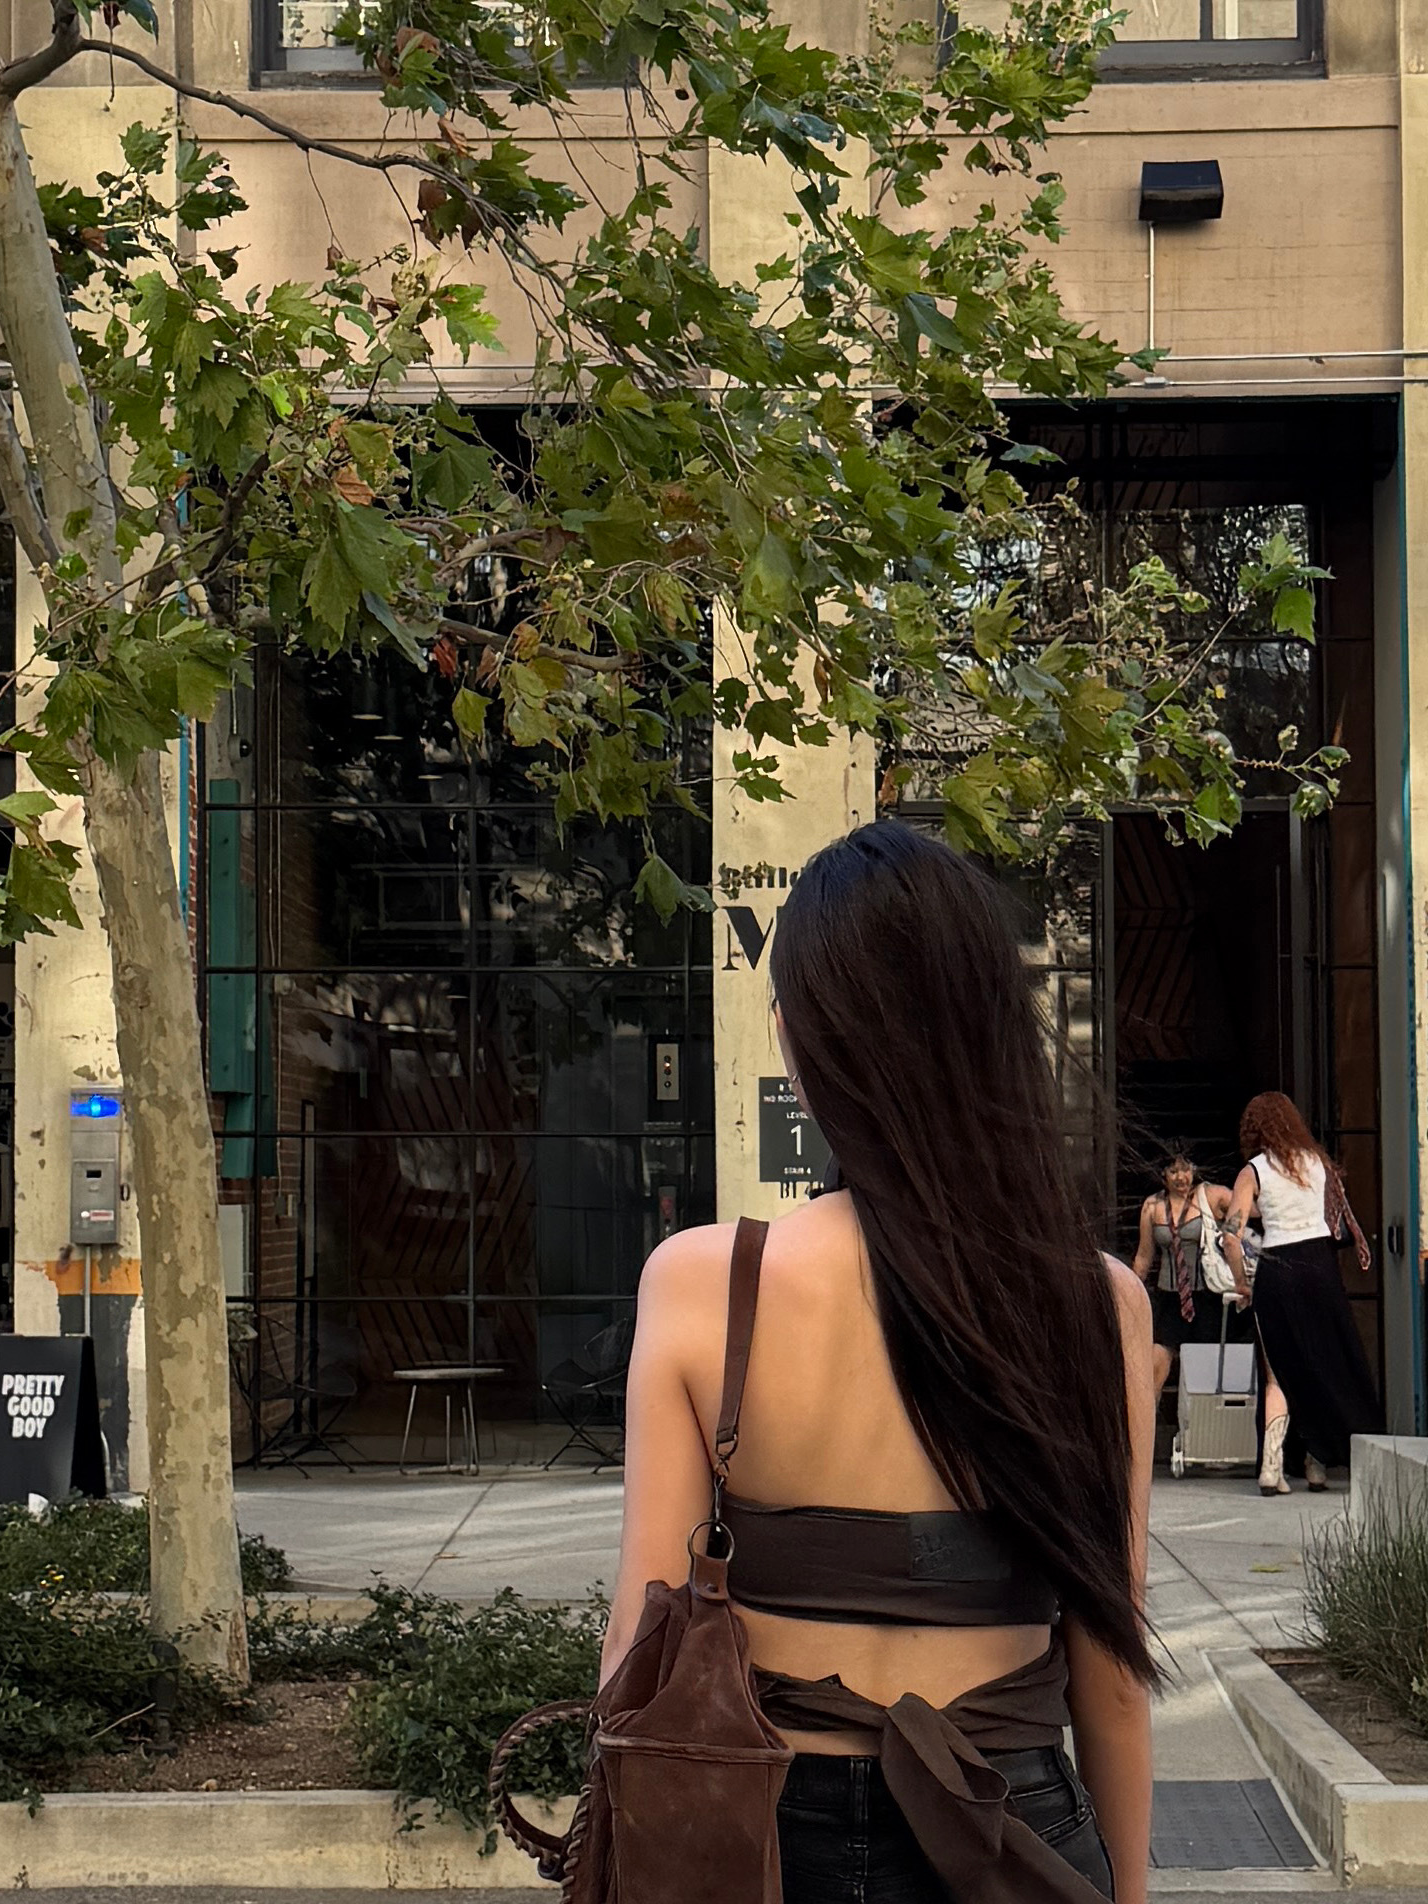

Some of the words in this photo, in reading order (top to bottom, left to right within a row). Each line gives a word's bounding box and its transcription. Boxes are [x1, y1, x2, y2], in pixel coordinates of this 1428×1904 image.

[790, 1124, 802, 1156] 1
[1, 1374, 65, 1396] PRETTY
[7, 1396, 55, 1417] GOOD
[12, 1417, 47, 1439] BOY
